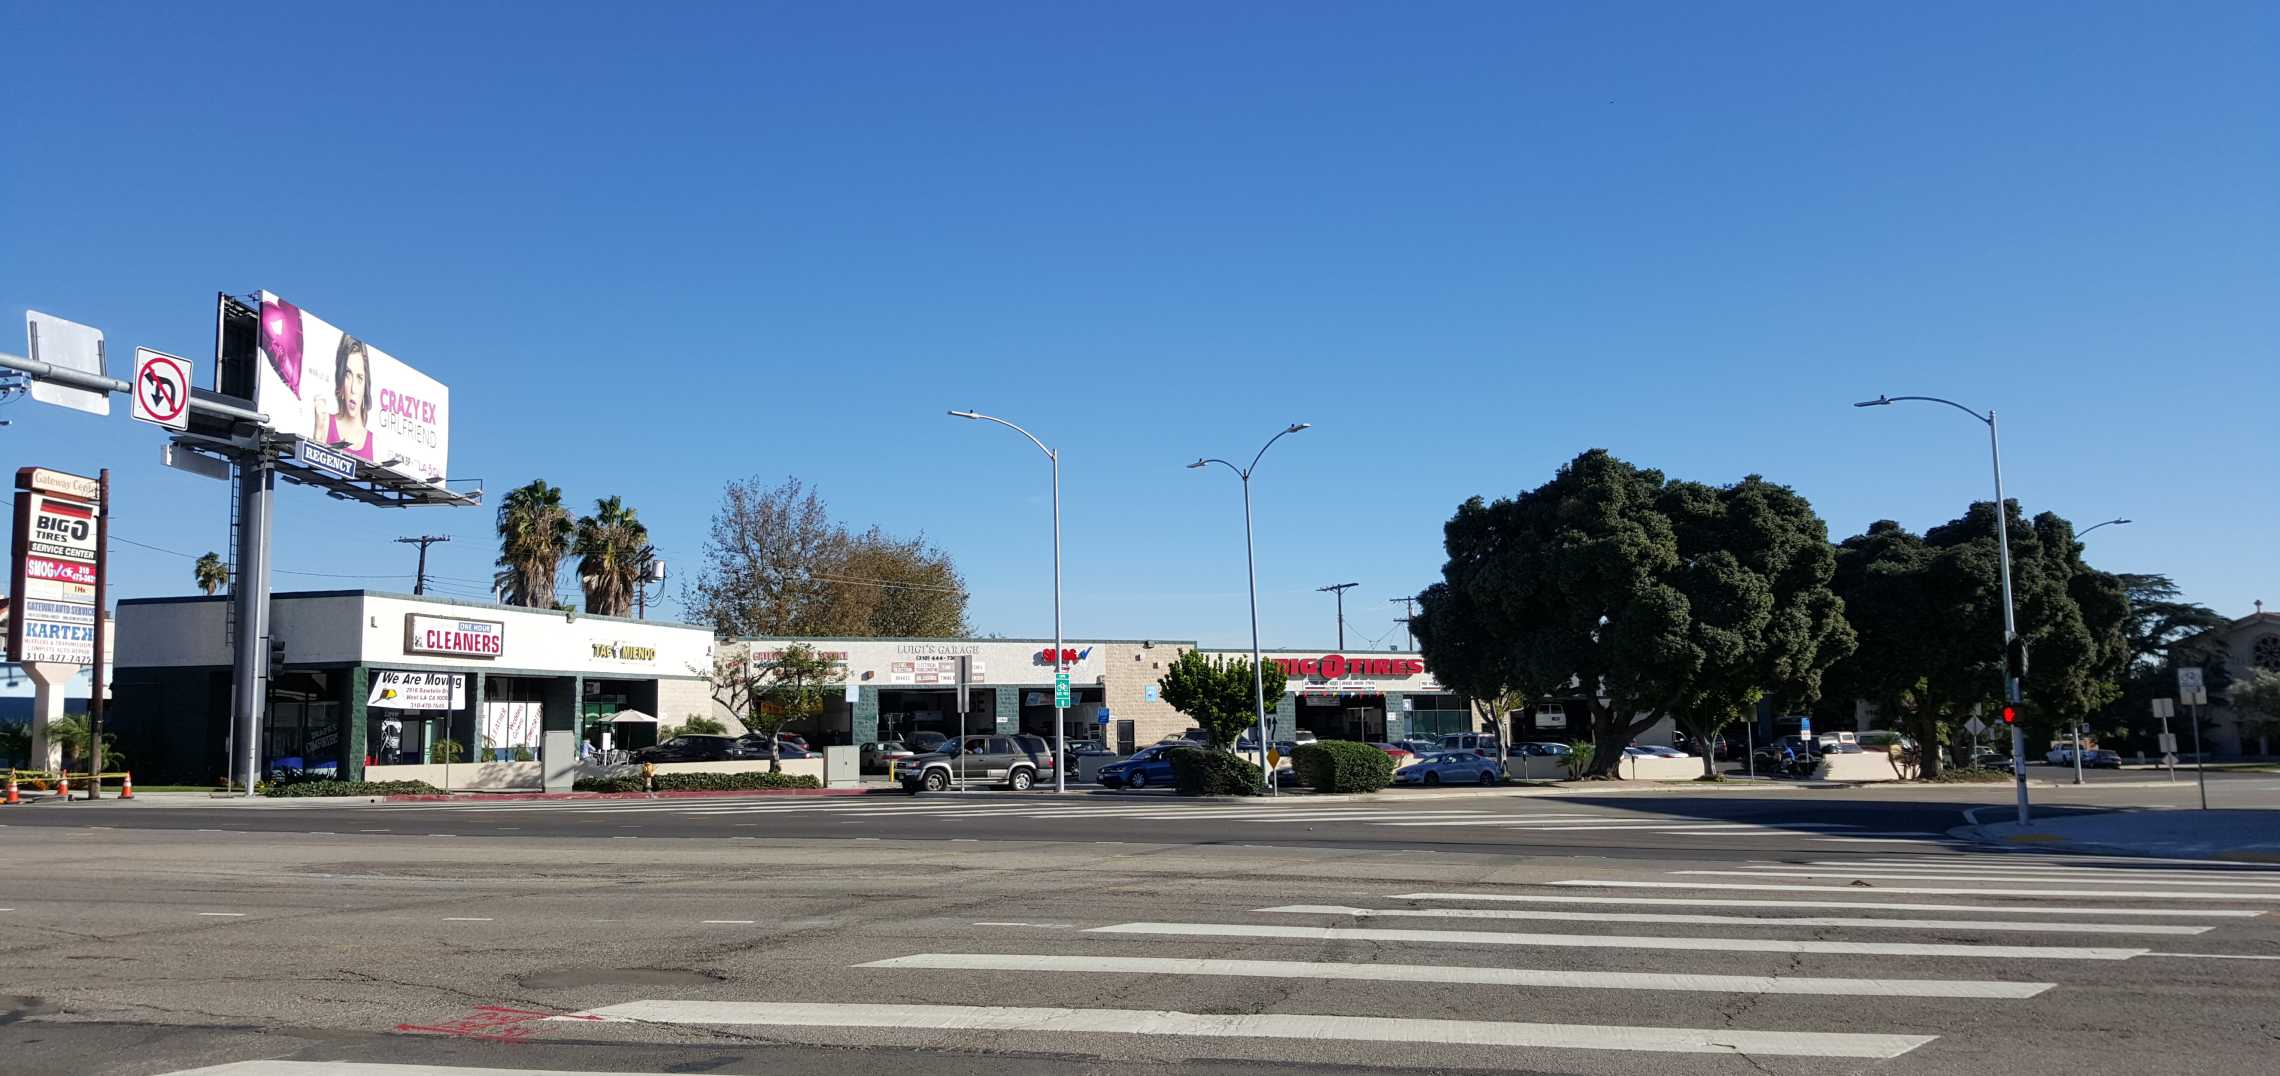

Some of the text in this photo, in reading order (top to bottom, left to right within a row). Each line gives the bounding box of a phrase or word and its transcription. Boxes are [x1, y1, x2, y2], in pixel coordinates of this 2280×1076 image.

[380, 388, 436, 425] CRAZY EX
[379, 408, 437, 449] GIRLFRIEND
[305, 446, 353, 474] REGENCY
[36, 471, 72, 490] Gateway
[36, 515, 89, 541] BIG O
[36, 530, 68, 543] TIRES
[31, 542, 95, 559] SERVICE CENTER
[28, 559, 54, 578] SMOG
[461, 623, 490, 632] ONE HOUR
[427, 629, 499, 653] CLEANERS
[897, 644, 979, 655] LUIGI'S GARAGE
[1321, 654, 1346, 680] O
[1346, 658, 1425, 676] TIRES
[382, 672, 399, 684] We
[402, 673, 422, 685] Are
